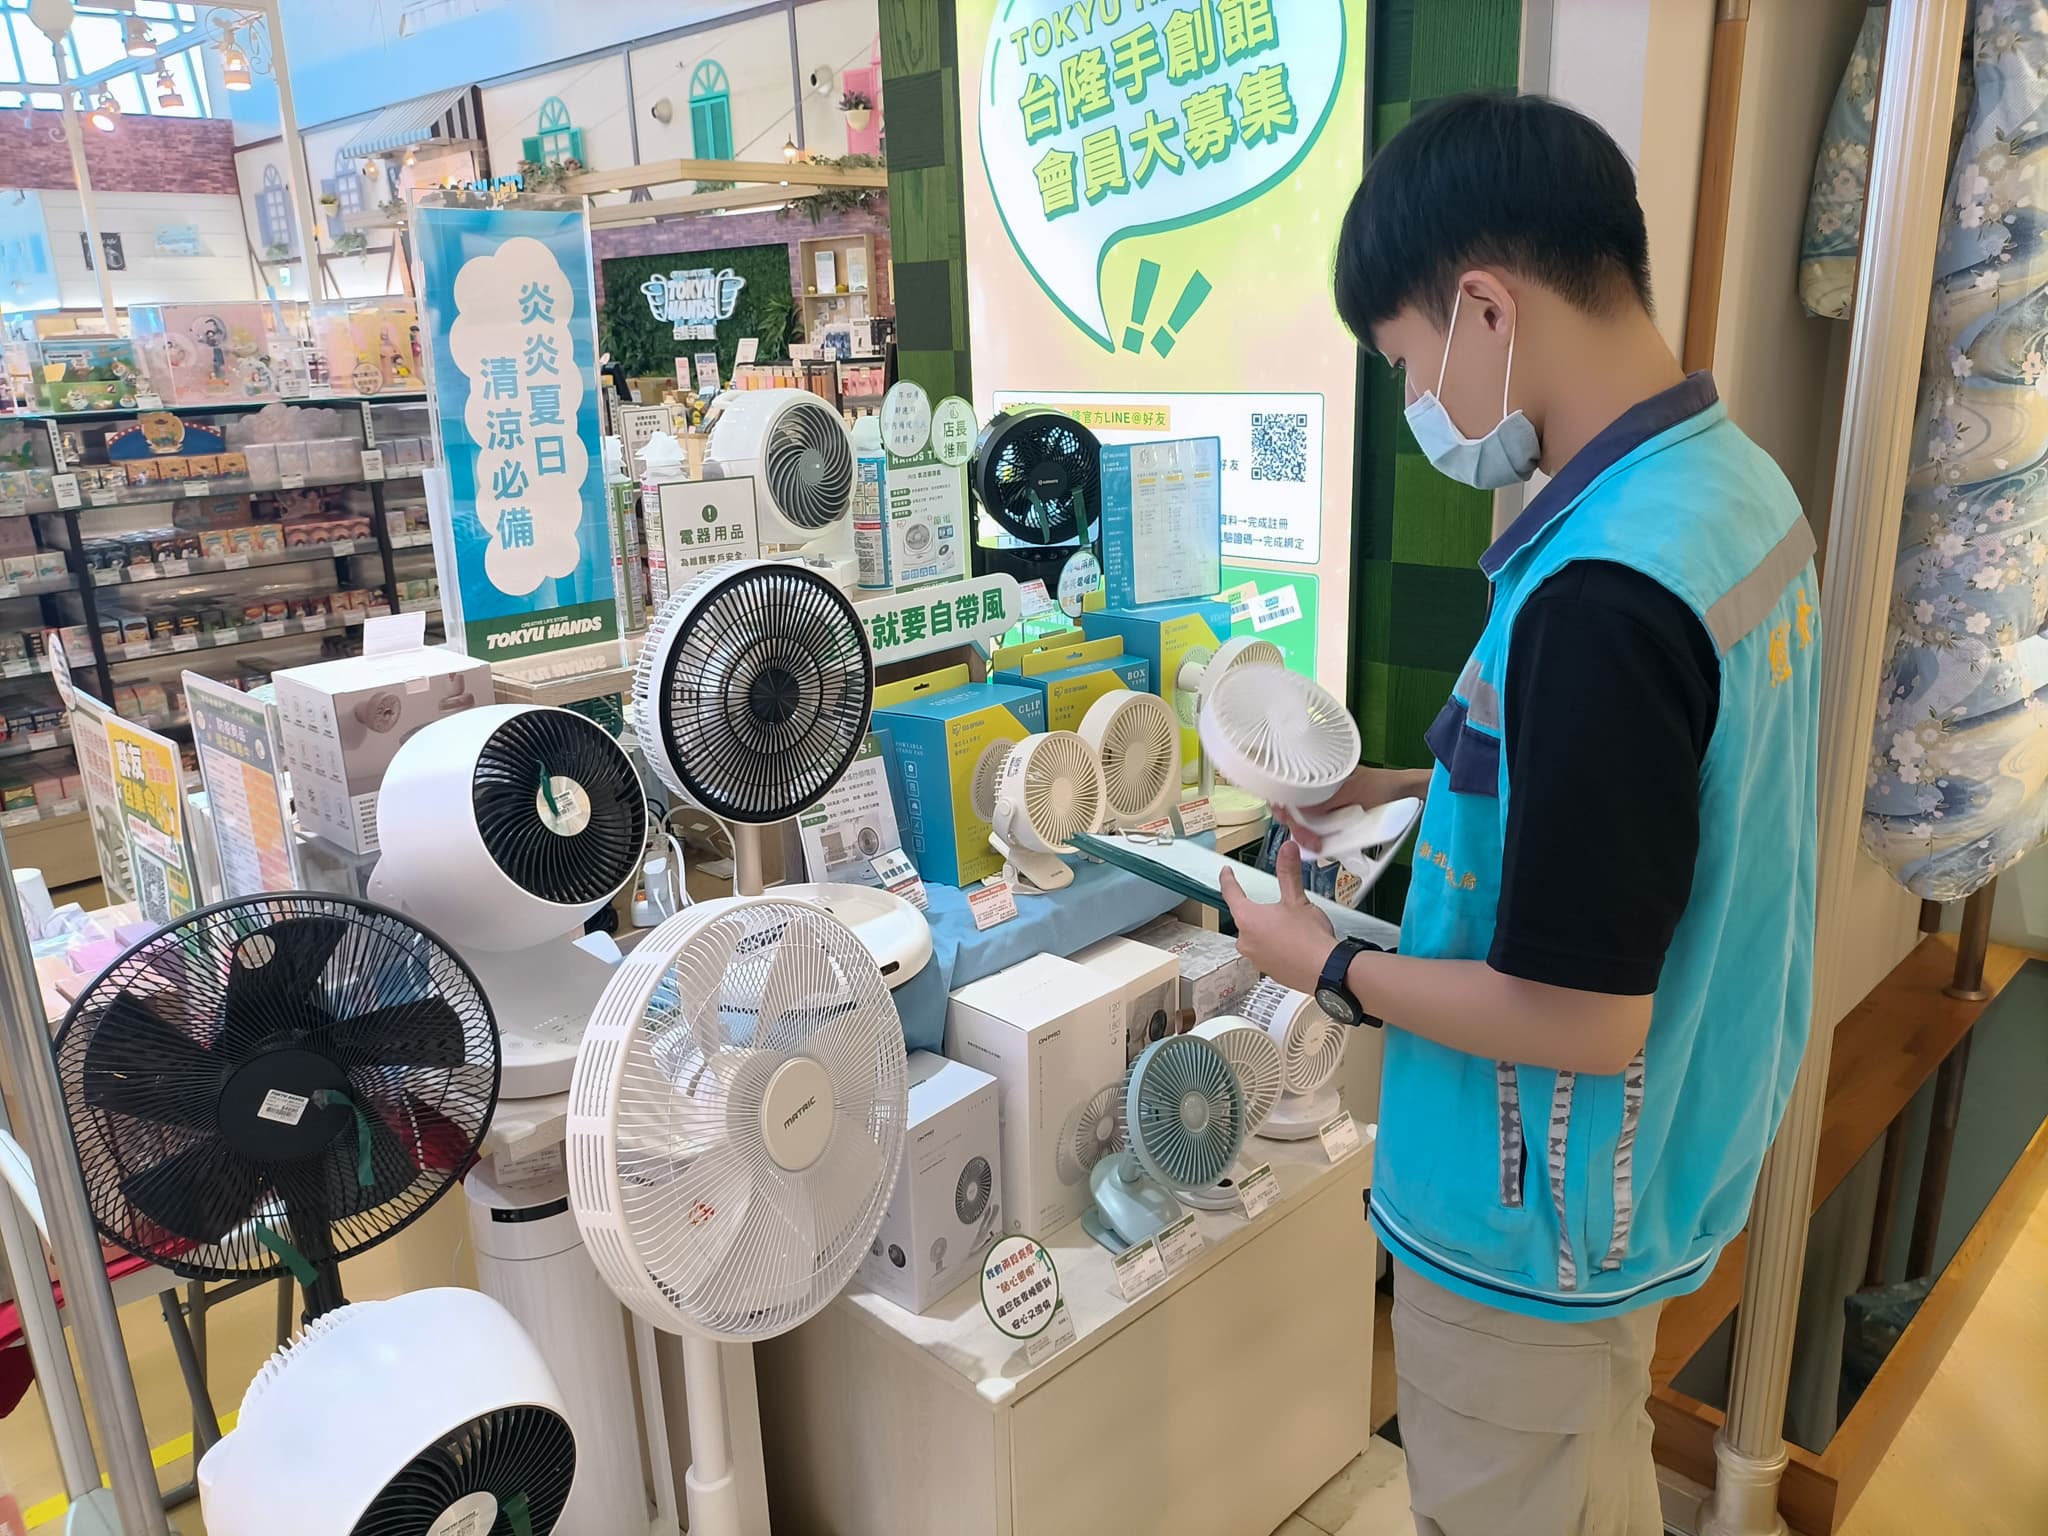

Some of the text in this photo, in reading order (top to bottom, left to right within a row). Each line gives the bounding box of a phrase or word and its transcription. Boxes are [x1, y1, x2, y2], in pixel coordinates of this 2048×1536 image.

[1018, 0, 1276, 145] 台隆手創館
[1032, 61, 1298, 222] 會員大募集
[667, 278, 715, 300] TOKYU
[517, 280, 567, 478] 炎炎夏日
[944, 420, 968, 438] 店長
[479, 356, 535, 551] 清涼必備
[679, 524, 745, 546] 電器用品
[486, 616, 602, 650] TOKYU HANDS
[1127, 669, 1146, 680] BOX
[1018, 700, 1041, 714] CLIP
[783, 1095, 816, 1130] MATRIC
